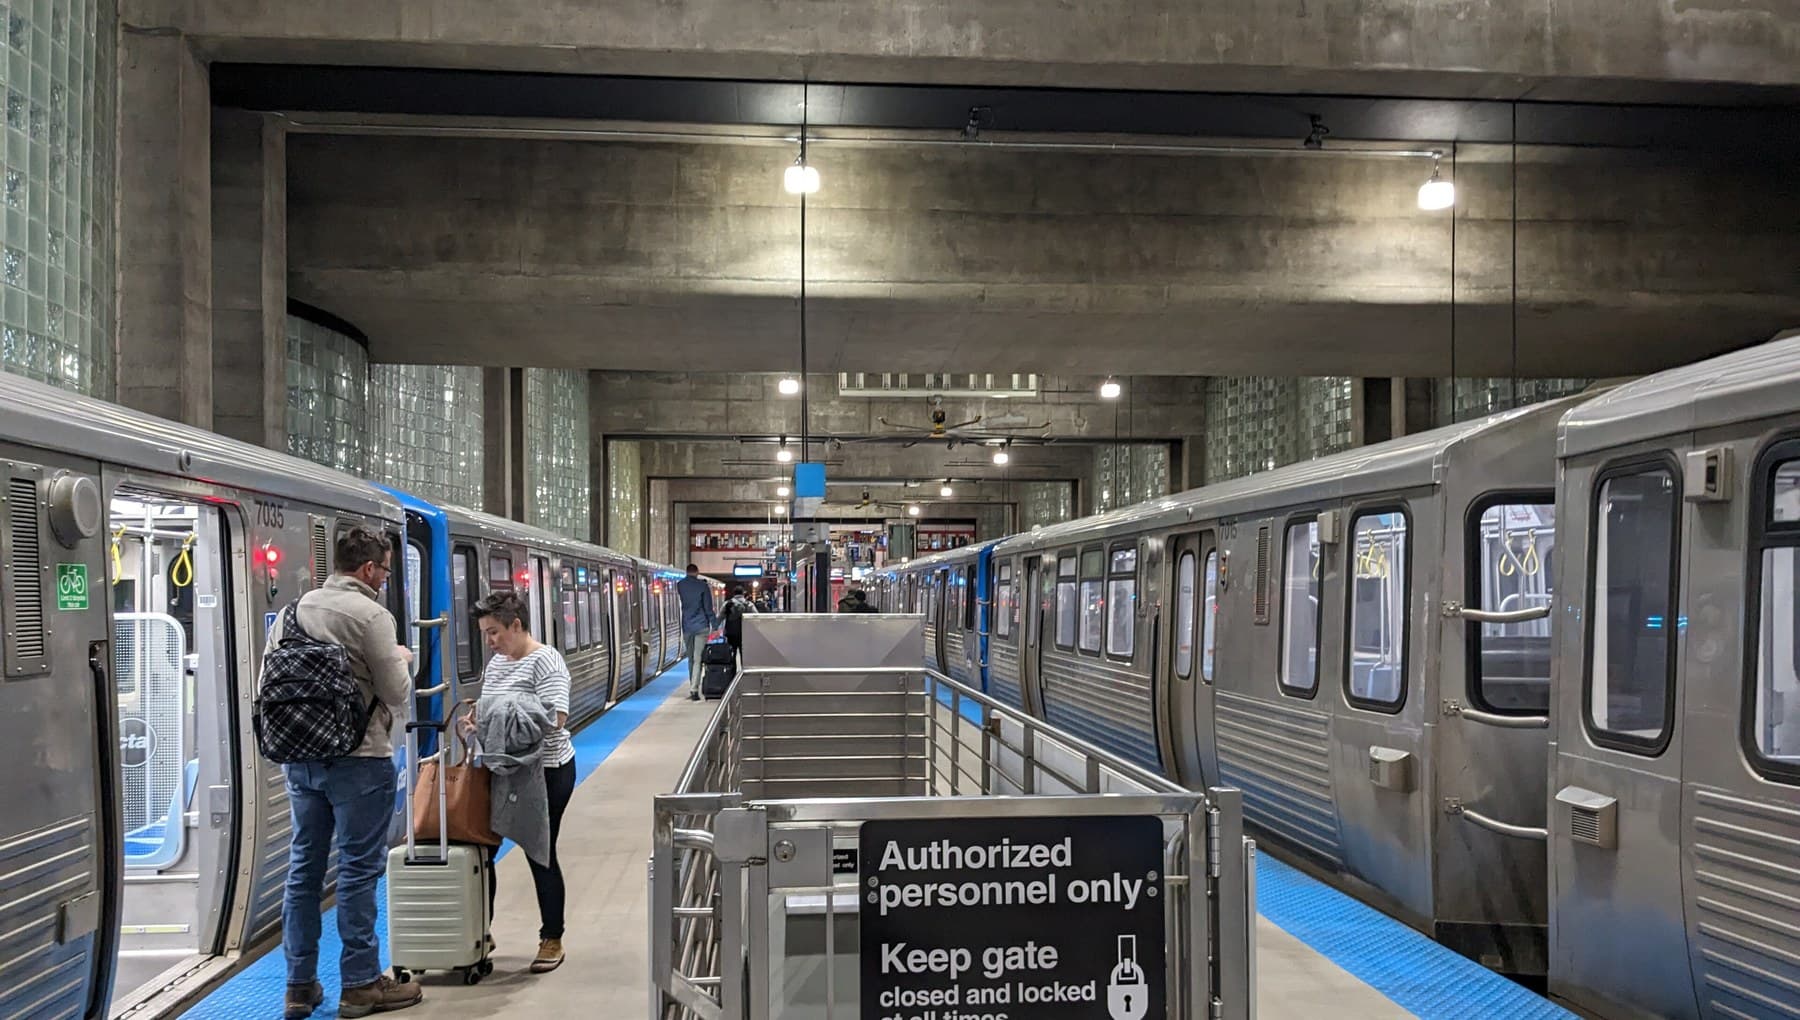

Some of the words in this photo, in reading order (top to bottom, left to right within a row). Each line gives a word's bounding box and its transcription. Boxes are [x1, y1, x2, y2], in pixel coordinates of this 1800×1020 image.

[254, 499, 284, 529] 7035
[879, 837, 1072, 871] Authorized
[880, 873, 1056, 916] personnel
[1067, 872, 1143, 910] only
[881, 942, 972, 980] Keep
[982, 941, 1058, 979] gate
[879, 984, 960, 1007] closed
[965, 982, 1011, 1005] and
[1018, 980, 1096, 1003] locked
